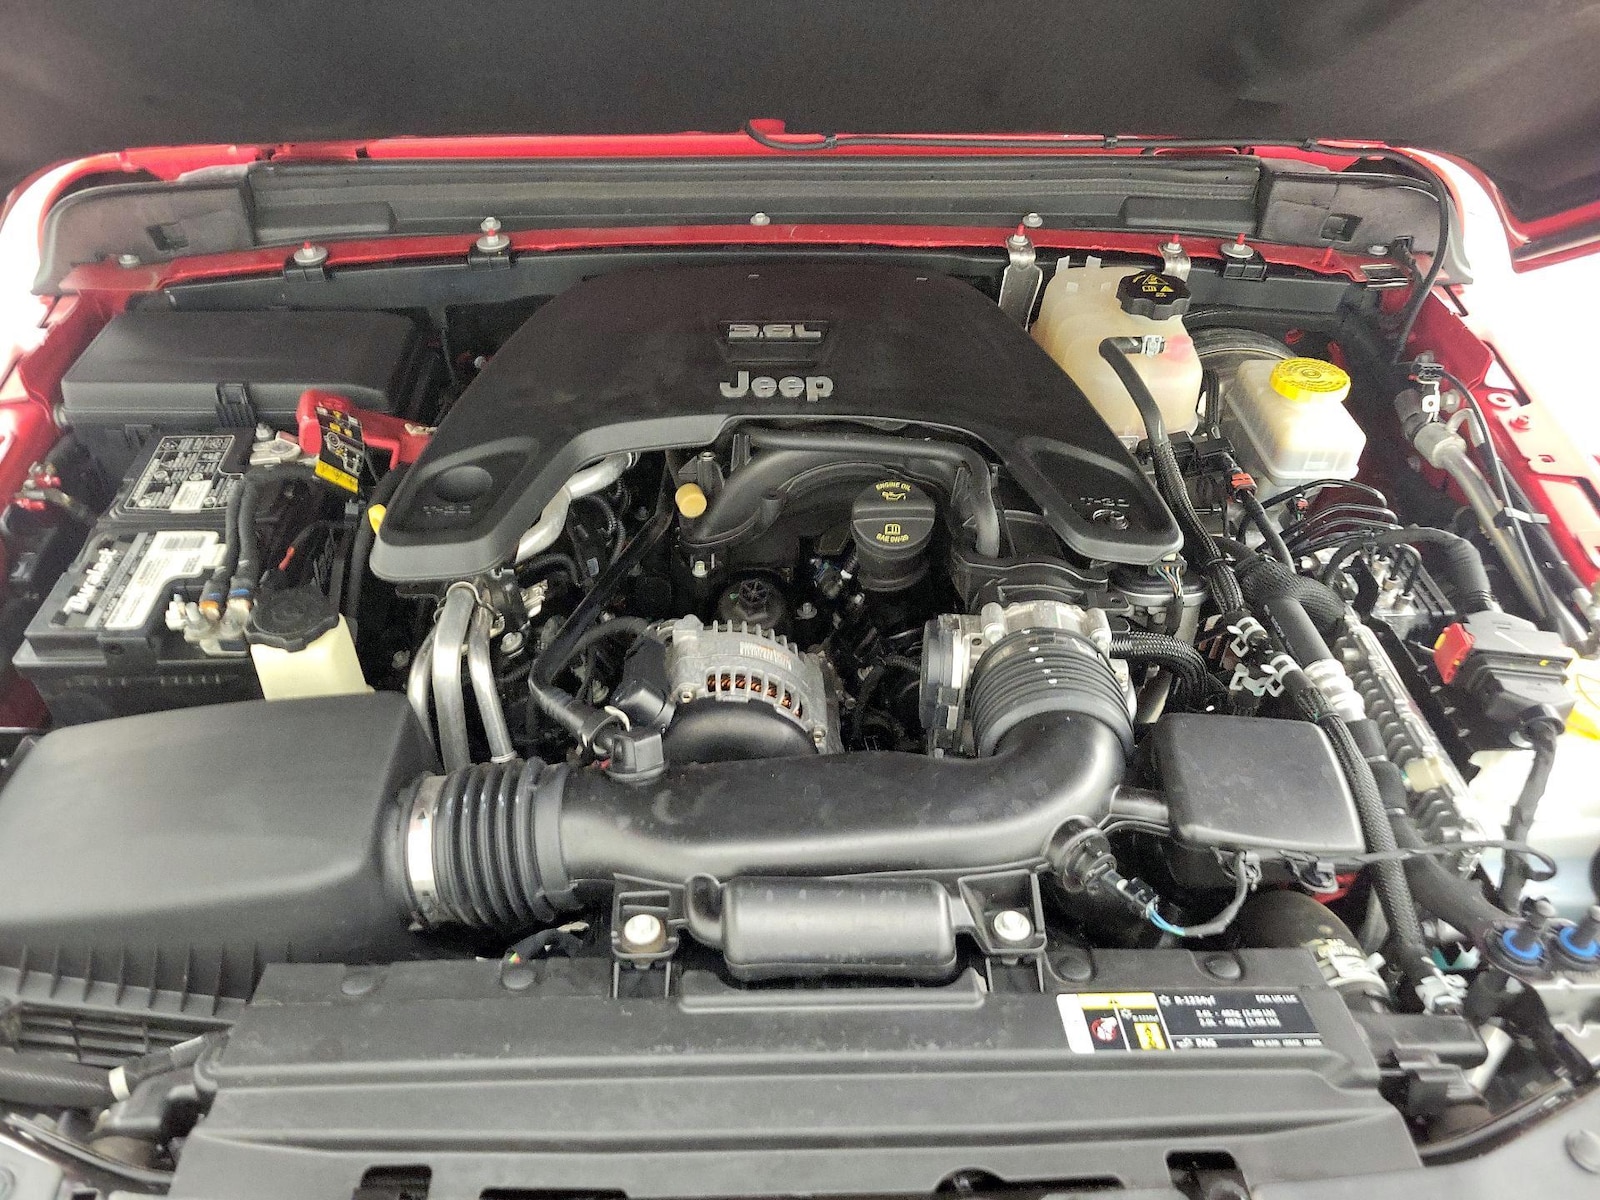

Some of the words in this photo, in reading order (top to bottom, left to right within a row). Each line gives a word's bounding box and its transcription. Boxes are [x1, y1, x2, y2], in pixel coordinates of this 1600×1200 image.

[728, 324, 821, 338] 3.6L
[720, 371, 834, 401] Jeep
[875, 481, 900, 491] ENGINE
[901, 483, 912, 492] OIL
[63, 548, 118, 615] Duralast
[1174, 995, 1217, 1006] R-1234yf
[1196, 1037, 1218, 1048] PAG
